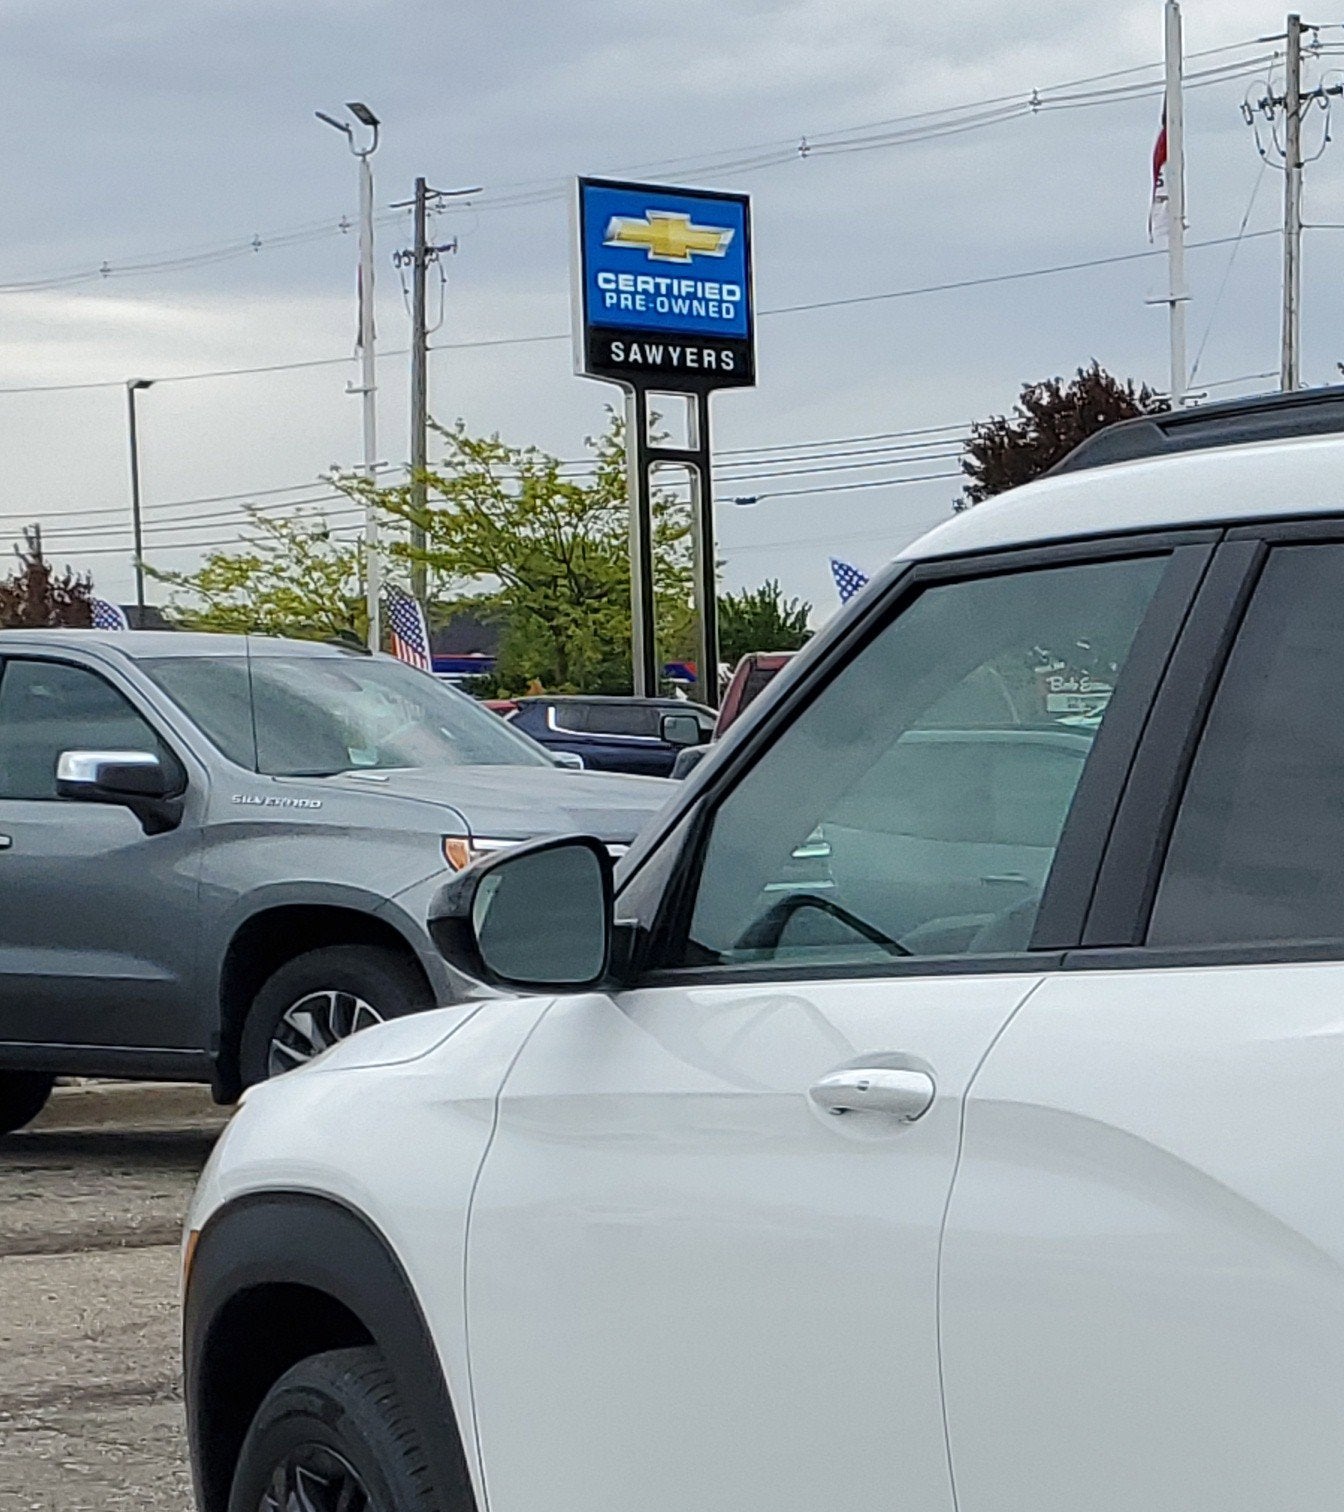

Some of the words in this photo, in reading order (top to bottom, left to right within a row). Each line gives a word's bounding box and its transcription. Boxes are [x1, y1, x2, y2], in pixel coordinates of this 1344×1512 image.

[597, 271, 742, 301] CERTIFIED
[605, 291, 736, 320] PRE-OWNED
[610, 341, 735, 371] SAWYERS
